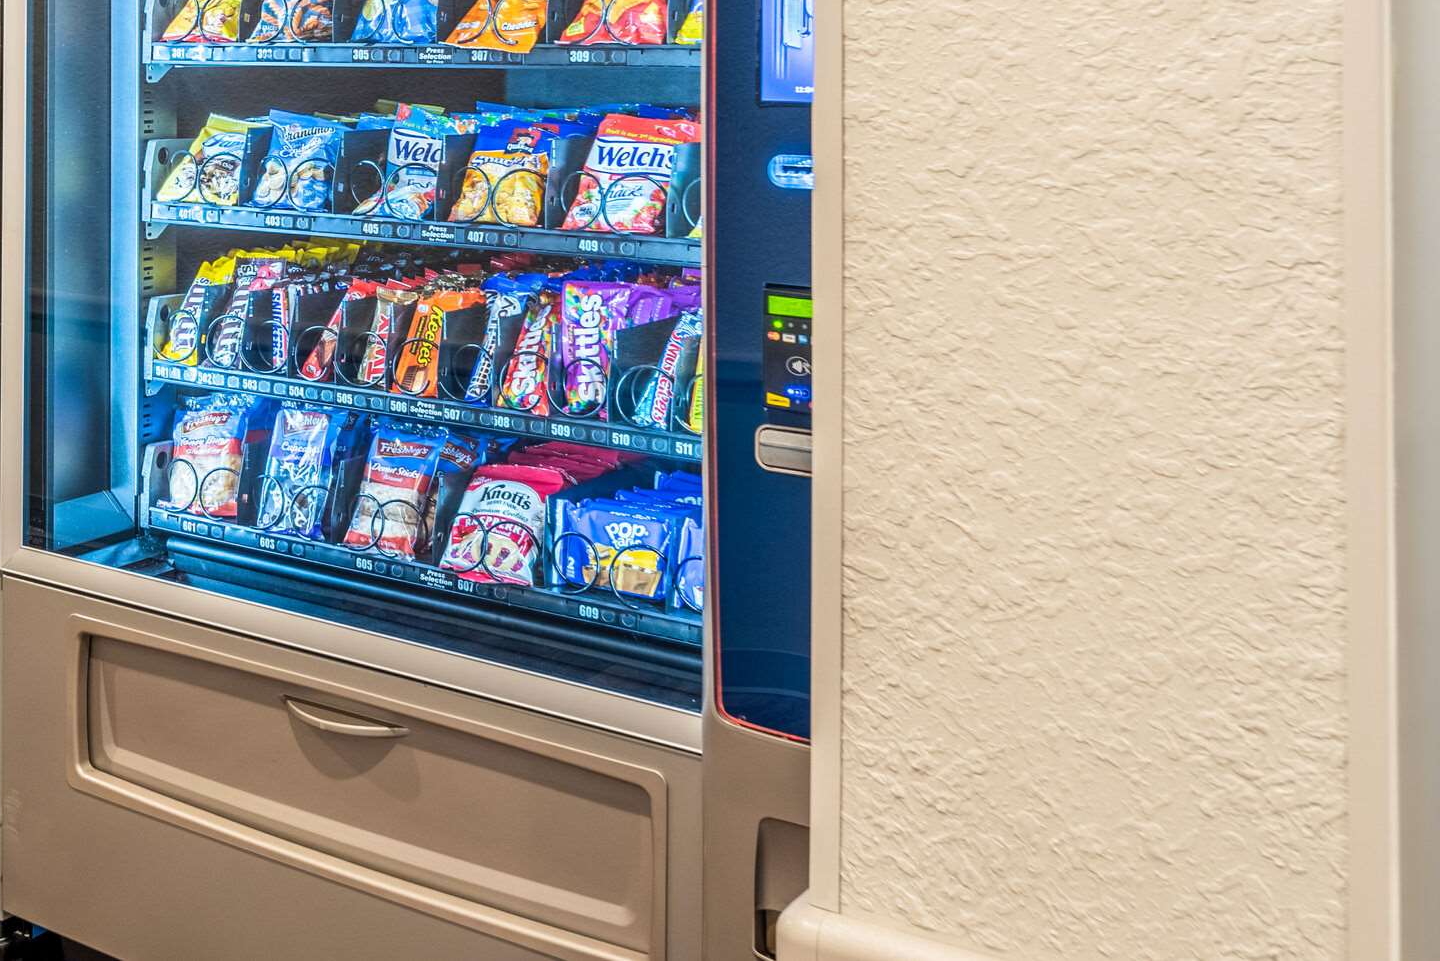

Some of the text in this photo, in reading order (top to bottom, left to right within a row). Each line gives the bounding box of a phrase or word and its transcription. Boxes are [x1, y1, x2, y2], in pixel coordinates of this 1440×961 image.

[257, 48, 272, 59] 303
[353, 50, 369, 60] 305
[471, 50, 488, 61] 307
[570, 50, 590, 63] 309
[395, 138, 442, 164] Welc
[265, 216, 280, 227] 403
[362, 223, 379, 234] 405
[421, 229, 455, 239] Selection
[467, 231, 484, 243] 407
[579, 239, 598, 251] 409
[242, 378, 257, 390] 503
[289, 385, 304, 397] 504
[336, 393, 352, 405] 505
[417, 401, 435, 409] Press
[390, 400, 407, 413] 506
[410, 406, 442, 416] Selection
[444, 408, 460, 420] 507
[551, 423, 570, 437] 509
[612, 432, 630, 446] 510
[675, 441, 693, 455] 511
[480, 484, 531, 510] Knott's
[182, 520, 196, 532] 601
[260, 536, 275, 549] 603
[356, 558, 372, 571] 605
[420, 573, 453, 587] Selection
[458, 579, 473, 592] 607
[579, 605, 599, 619] 609
